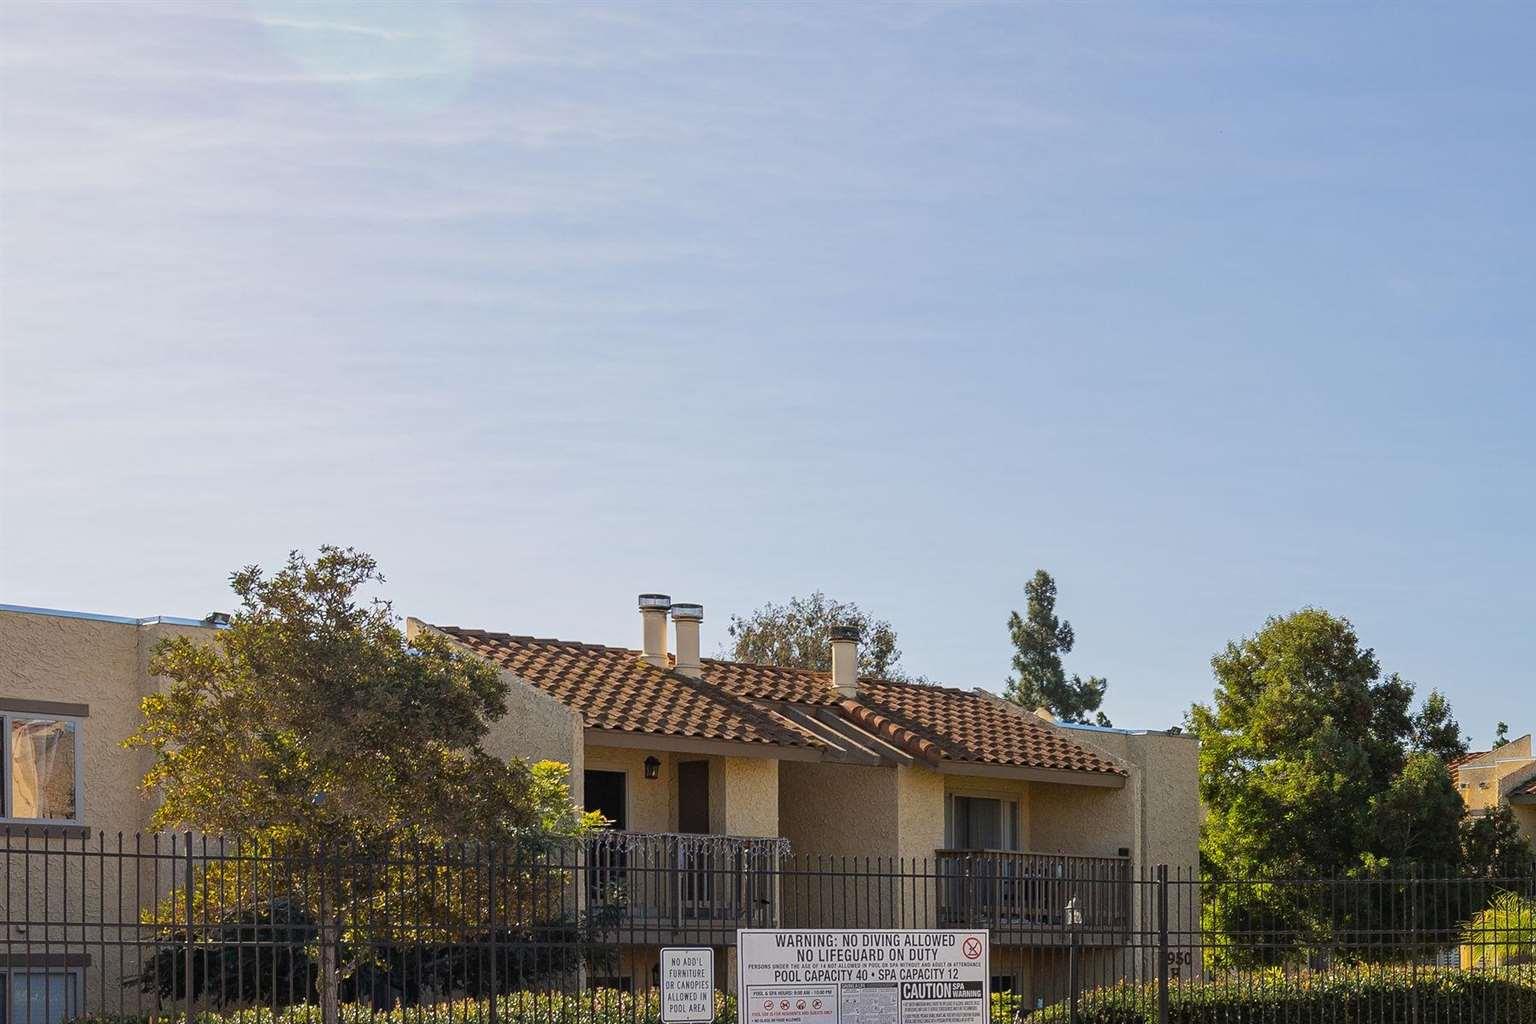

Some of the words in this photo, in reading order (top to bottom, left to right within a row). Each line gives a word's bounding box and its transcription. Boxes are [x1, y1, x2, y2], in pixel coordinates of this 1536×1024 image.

[775, 934, 838, 948] WARNING:
[843, 934, 858, 947] NO
[862, 934, 900, 947] DIVING
[904, 934, 956, 947] ALLOWED
[797, 949, 814, 962] NO
[819, 949, 884, 961] LIFEGUARD
[889, 949, 904, 961] ON
[910, 948, 938, 960] DUTY
[672, 958, 681, 966] NO
[669, 969, 705, 978] FURNITURE
[774, 970, 801, 982] POOL
[805, 970, 853, 982] CAPACITY
[856, 970, 868, 981] 40
[879, 969, 897, 981] SPA
[900, 969, 945, 980] CAPACITY
[948, 969, 959, 979] 12
[665, 981, 675, 990] OR
[677, 981, 710, 989] CANOPIES
[903, 982, 952, 999] CAUTION
[952, 983, 965, 991] SPA
[952, 990, 982, 998] WARNING
[667, 993, 697, 1001] ALLOWED
[700, 992, 707, 1000] IN
[670, 1004, 685, 1012] POOL
[689, 1004, 706, 1012] AREA
